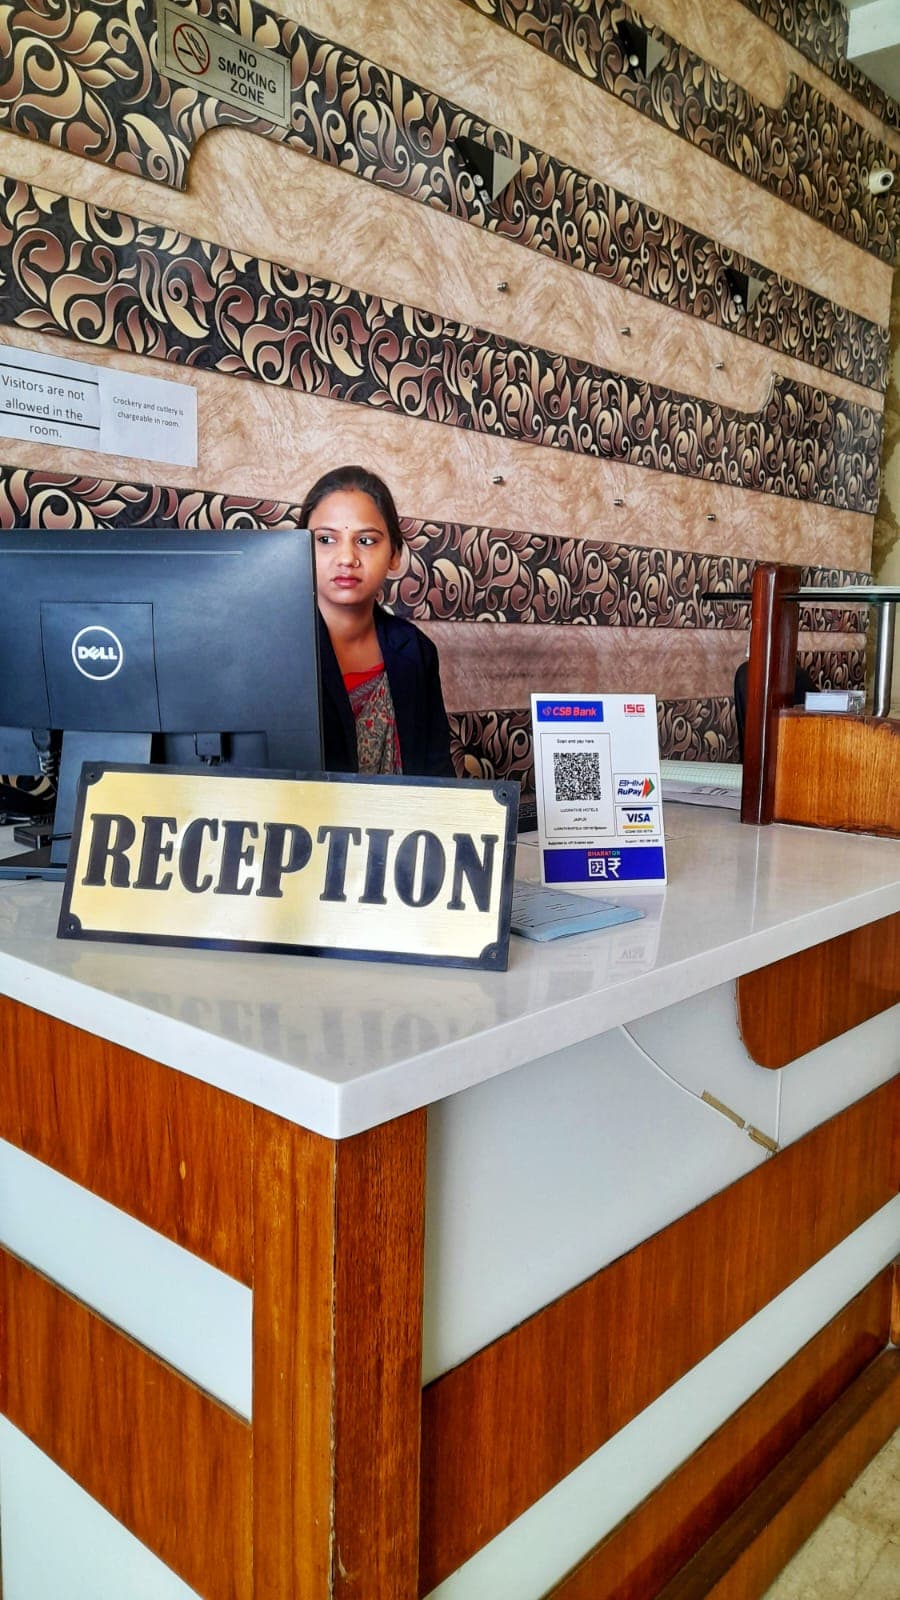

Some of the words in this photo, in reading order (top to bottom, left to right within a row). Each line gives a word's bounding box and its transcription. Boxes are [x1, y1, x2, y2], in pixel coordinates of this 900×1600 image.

[239, 49, 257, 68] NO
[218, 56, 277, 94] SMOKING
[230, 78, 265, 105] ZONE
[1, 374, 44, 393] Visitors
[47, 384, 65, 397] are
[67, 390, 85, 401] not
[5, 398, 50, 415] allowed
[53, 406, 64, 417] in
[65, 408, 83, 421] the
[113, 396, 142, 409] Crockery
[143, 402, 155, 411] and
[156, 405, 178, 415] cutlery
[117, 411, 153, 423] chargeable
[154, 416, 161, 424] in
[29, 423, 62, 439] room.
[78, 645, 118, 661] DELL
[552, 706, 572, 716] CSB
[573, 706, 597, 717] Bank
[623, 704, 646, 713] ISG
[617, 788, 642, 797] RuPay
[627, 813, 651, 823] VISA
[81, 813, 500, 913] RECEPTION
